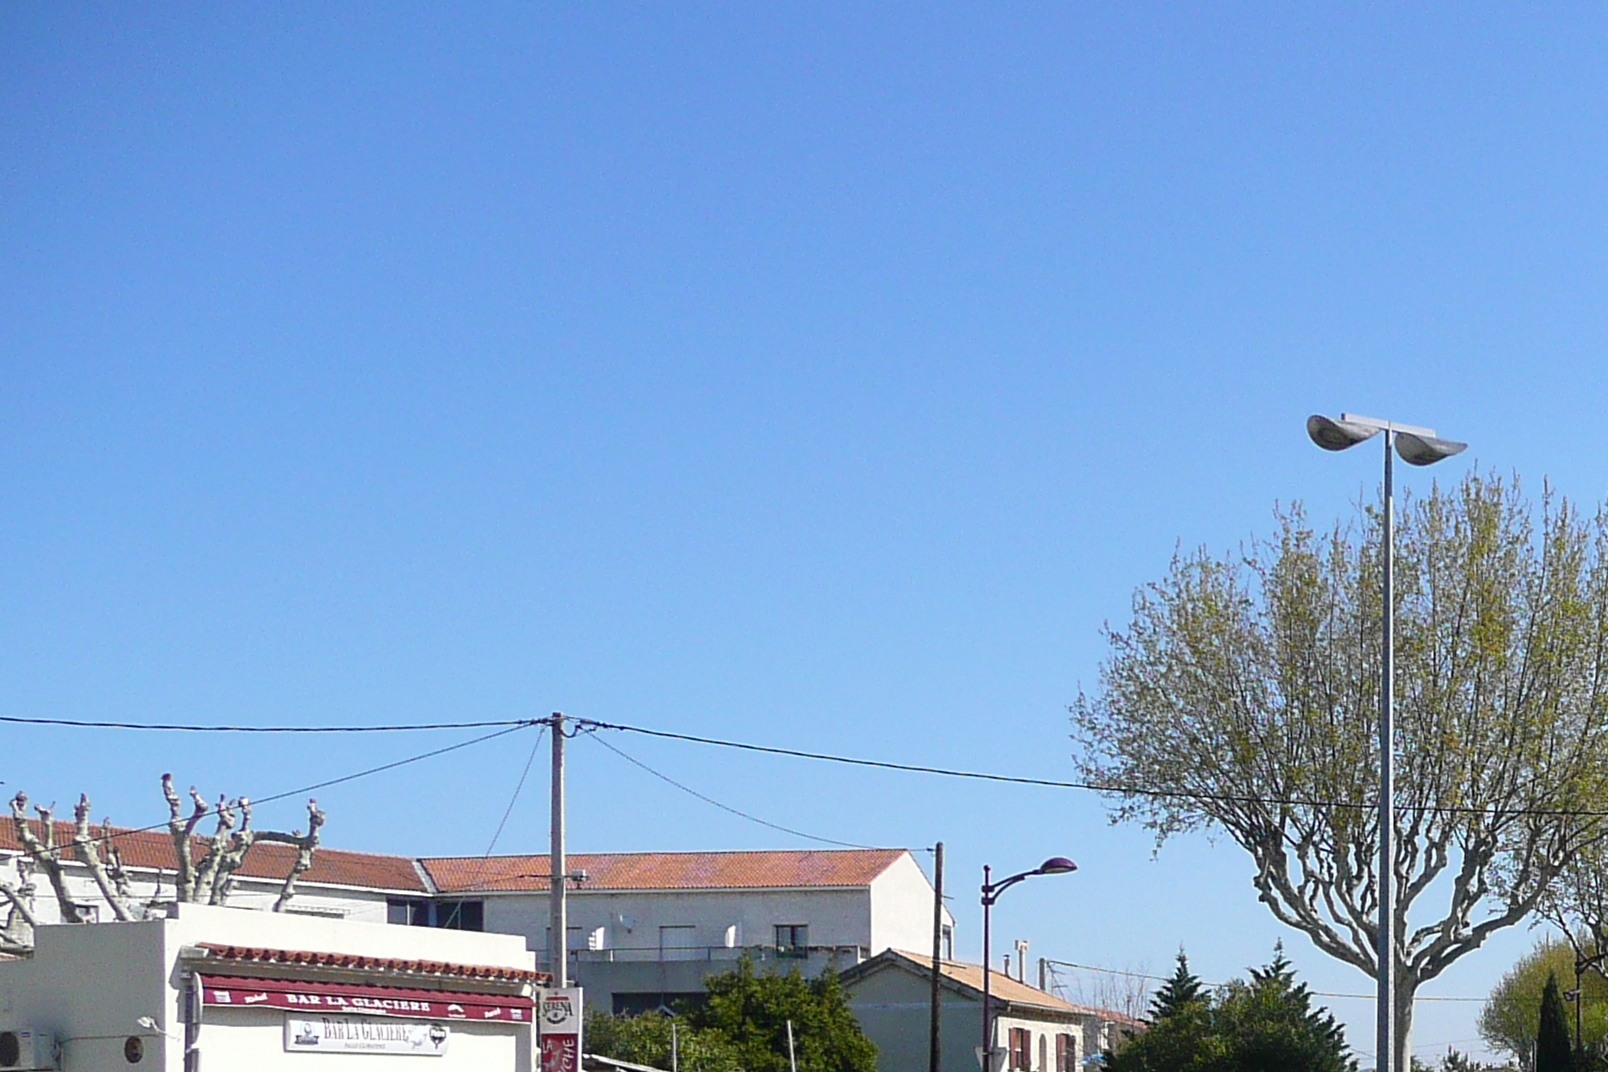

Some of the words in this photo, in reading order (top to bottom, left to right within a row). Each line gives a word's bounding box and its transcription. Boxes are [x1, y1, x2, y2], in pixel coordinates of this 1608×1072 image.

[286, 993, 322, 1005] BAR
[325, 995, 349, 1006] LA
[322, 1016, 345, 1040] BAR
[345, 1018, 360, 1040] LA
